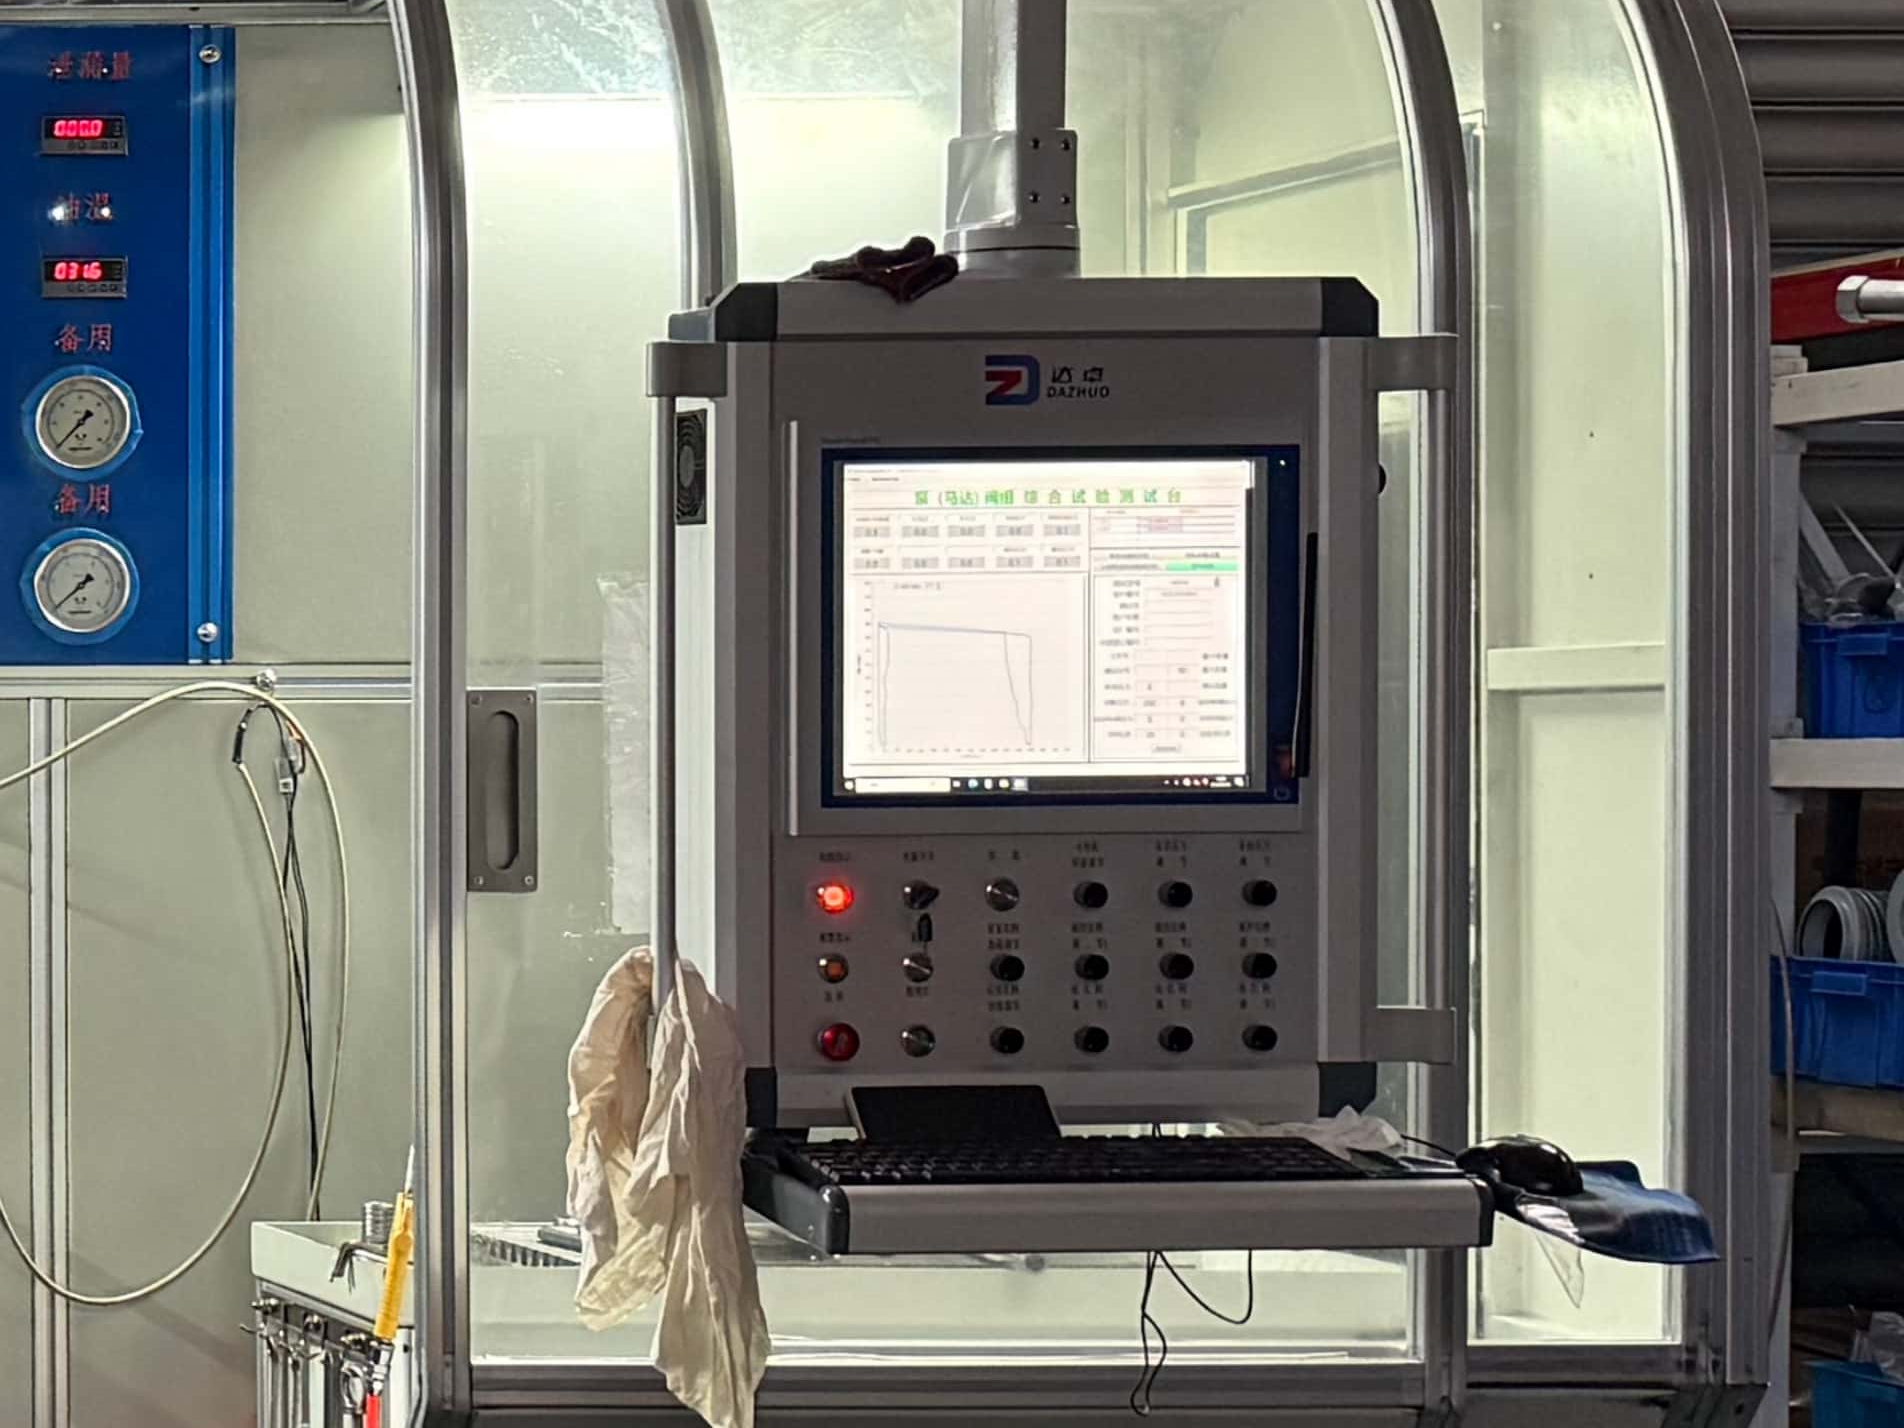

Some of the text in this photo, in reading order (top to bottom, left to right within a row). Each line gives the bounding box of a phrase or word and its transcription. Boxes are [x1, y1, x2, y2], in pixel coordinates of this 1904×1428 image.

[56, 323, 112, 352] 备用
[1047, 386, 1110, 398] DAZHUO
[55, 484, 110, 514] 备用
